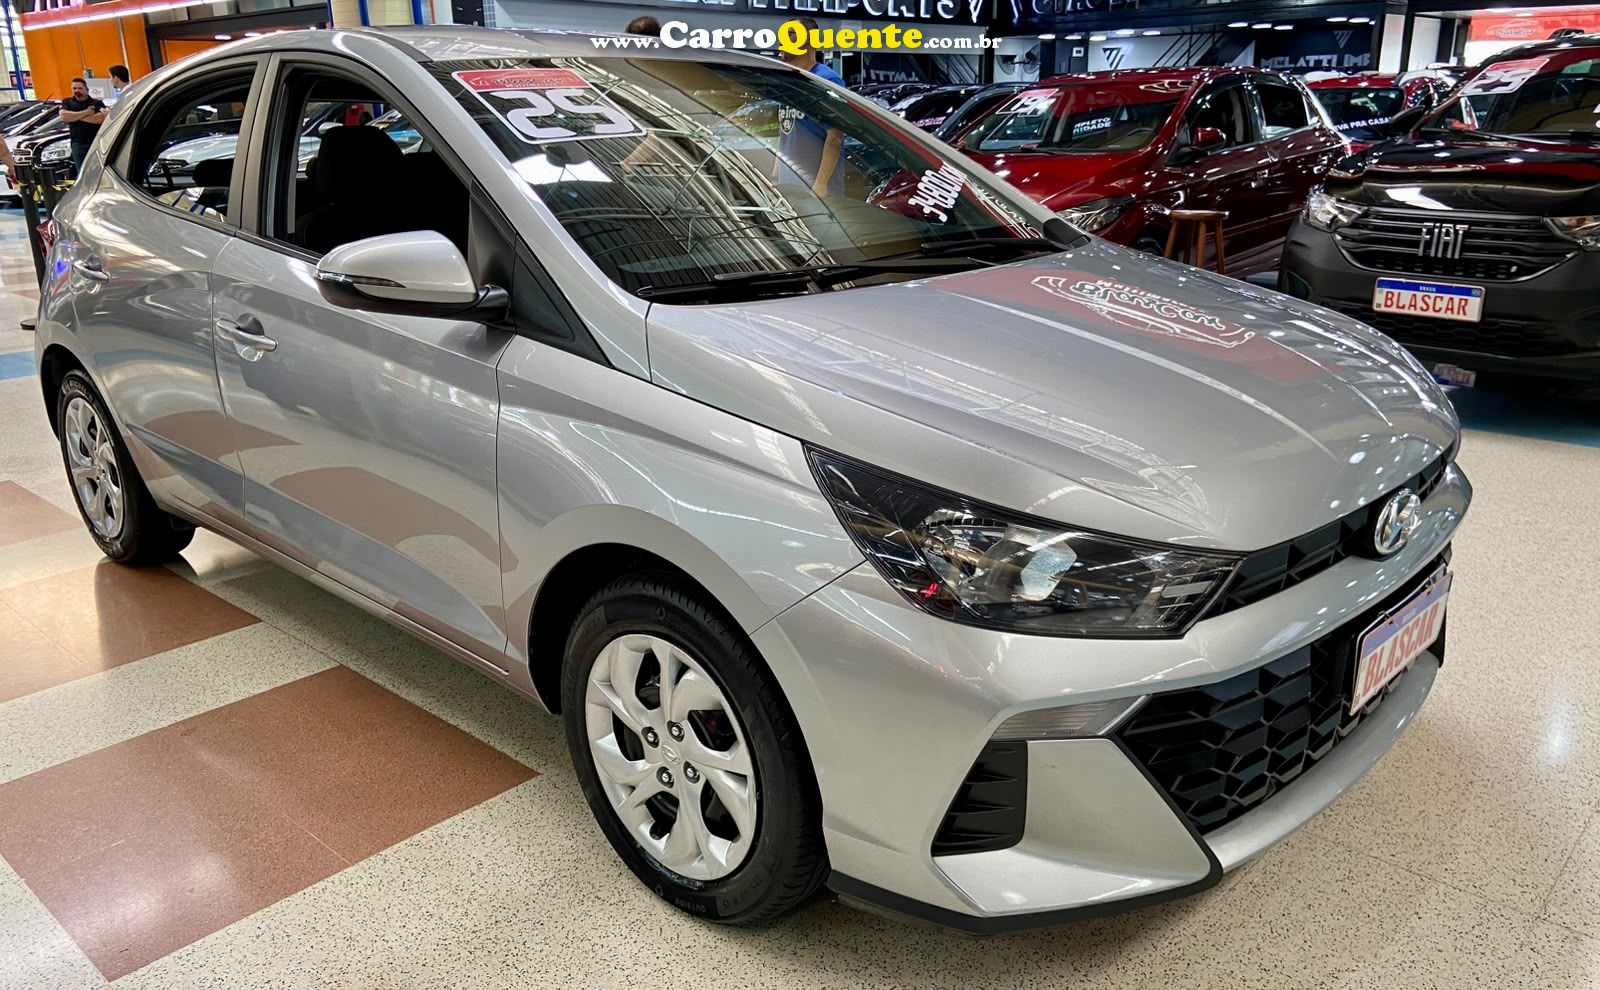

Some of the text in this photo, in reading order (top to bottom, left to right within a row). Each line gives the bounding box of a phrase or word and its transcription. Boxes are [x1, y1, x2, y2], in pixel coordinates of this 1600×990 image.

[1260, 54, 1337, 69] MELATTI
[490, 89, 635, 138] 25
[1350, 119, 1368, 129] PRA
[1418, 222, 1469, 259] FIAT
[1383, 290, 1469, 316] BLASCAR
[1363, 601, 1440, 698] BLASCAR
